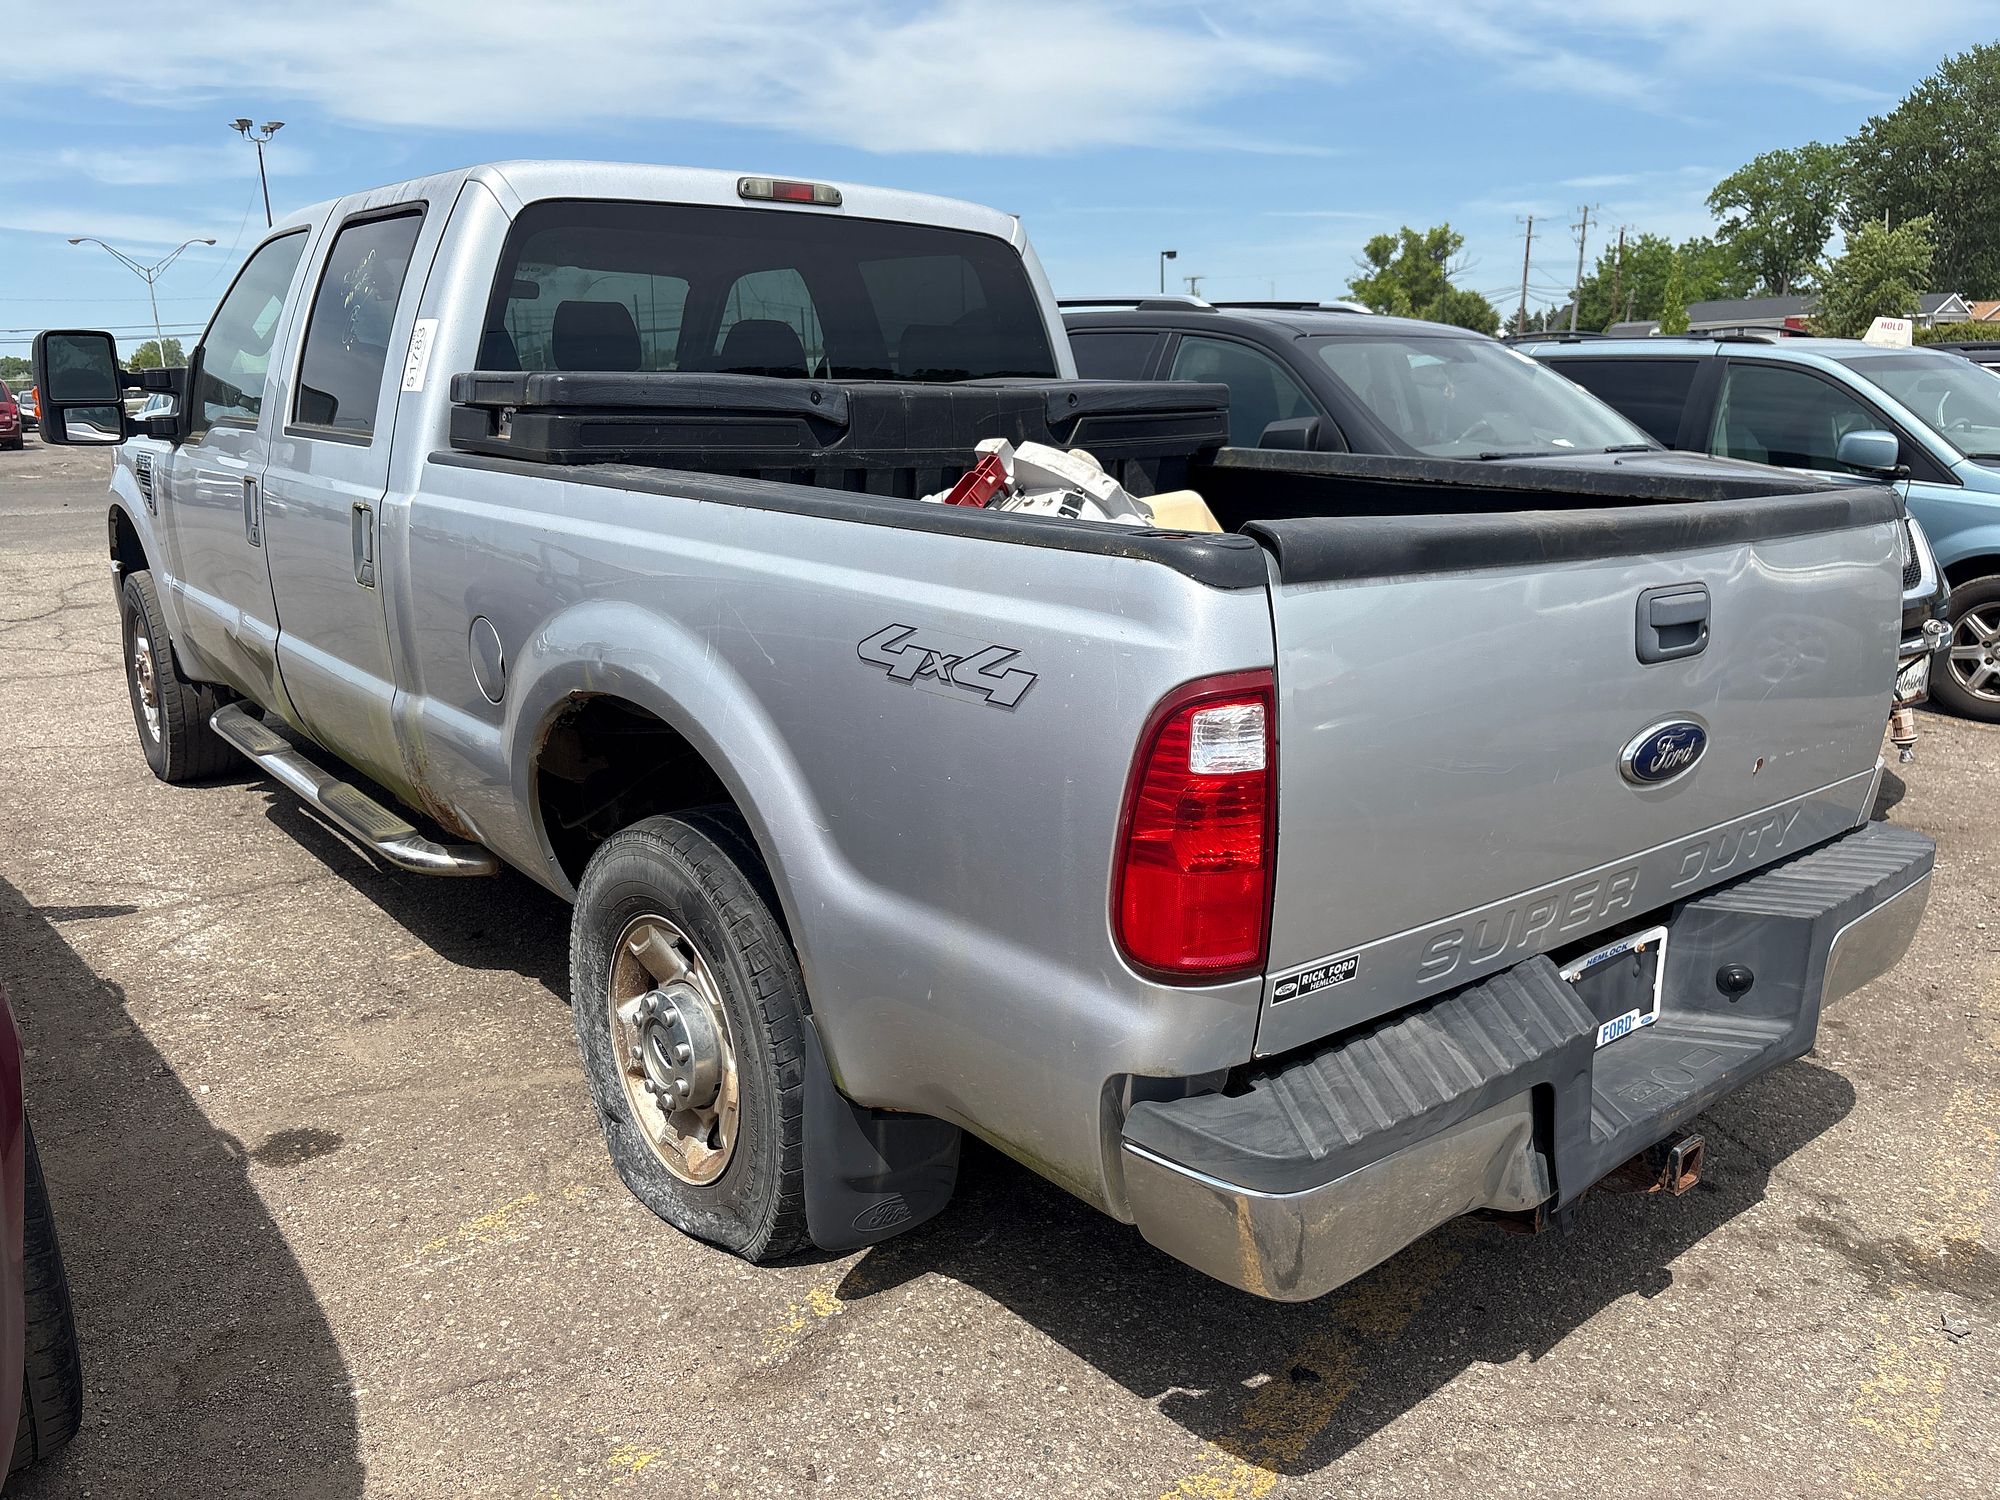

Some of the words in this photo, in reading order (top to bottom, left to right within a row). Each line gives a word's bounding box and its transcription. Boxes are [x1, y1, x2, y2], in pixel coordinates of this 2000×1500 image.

[1880, 321, 1904, 331] HOLD
[406, 327, 426, 388] 51783
[856, 622, 1040, 711] 4x4
[1649, 731, 1695, 773] Ford
[1415, 864, 1641, 985] SUPER
[1670, 804, 1803, 890] DUTY
[1586, 942, 1629, 967] HEMLOCK
[1301, 968, 1326, 985] RICK
[1328, 959, 1356, 977] FORD
[1310, 973, 1345, 990] HEMLOCK
[1602, 1014, 1632, 1044] FORD
